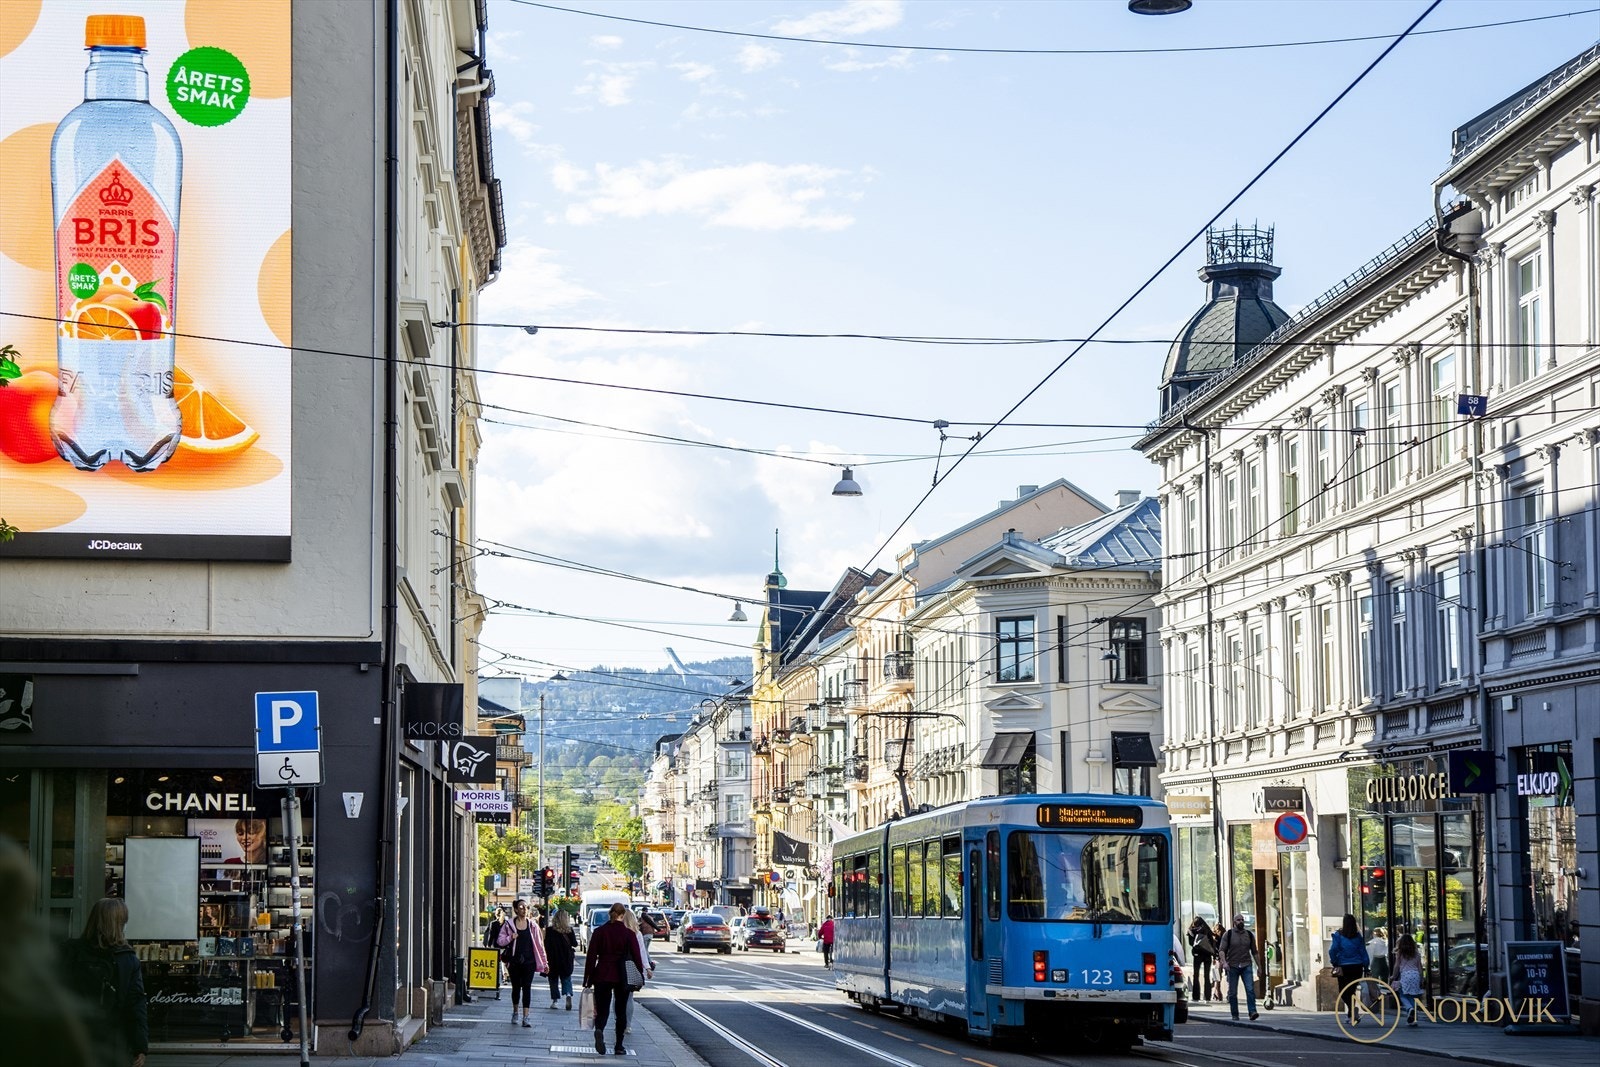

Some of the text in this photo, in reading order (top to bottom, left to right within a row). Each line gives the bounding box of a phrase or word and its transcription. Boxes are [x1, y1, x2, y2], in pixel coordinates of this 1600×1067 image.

[174, 66, 243, 93] ÅRETS
[176, 86, 236, 110] SMAK
[98, 208, 134, 216] FARRIS
[72, 218, 160, 247] BRIS
[69, 273, 97, 282] ÅRETS
[1467, 396, 1479, 405] 58
[1469, 406, 1477, 415] V
[88, 540, 142, 550] JCDecaux
[271, 700, 303, 744] P
[407, 722, 460, 736] KICKS
[1366, 772, 1457, 804] GULLBORGE
[461, 791, 501, 801] MORRIS
[146, 792, 257, 812] CHANEL
[474, 802, 509, 811] MORRIS
[1170, 801, 1207, 809] BIK BOK
[1267, 799, 1302, 808] VOLT
[781, 855, 806, 863] Valkyrien
[473, 959, 495, 968] SALE
[475, 971, 492, 980] 70%
[1081, 969, 1113, 985] 123
[1526, 968, 1547, 978] 10-19
[1528, 984, 1550, 995] 10-18
